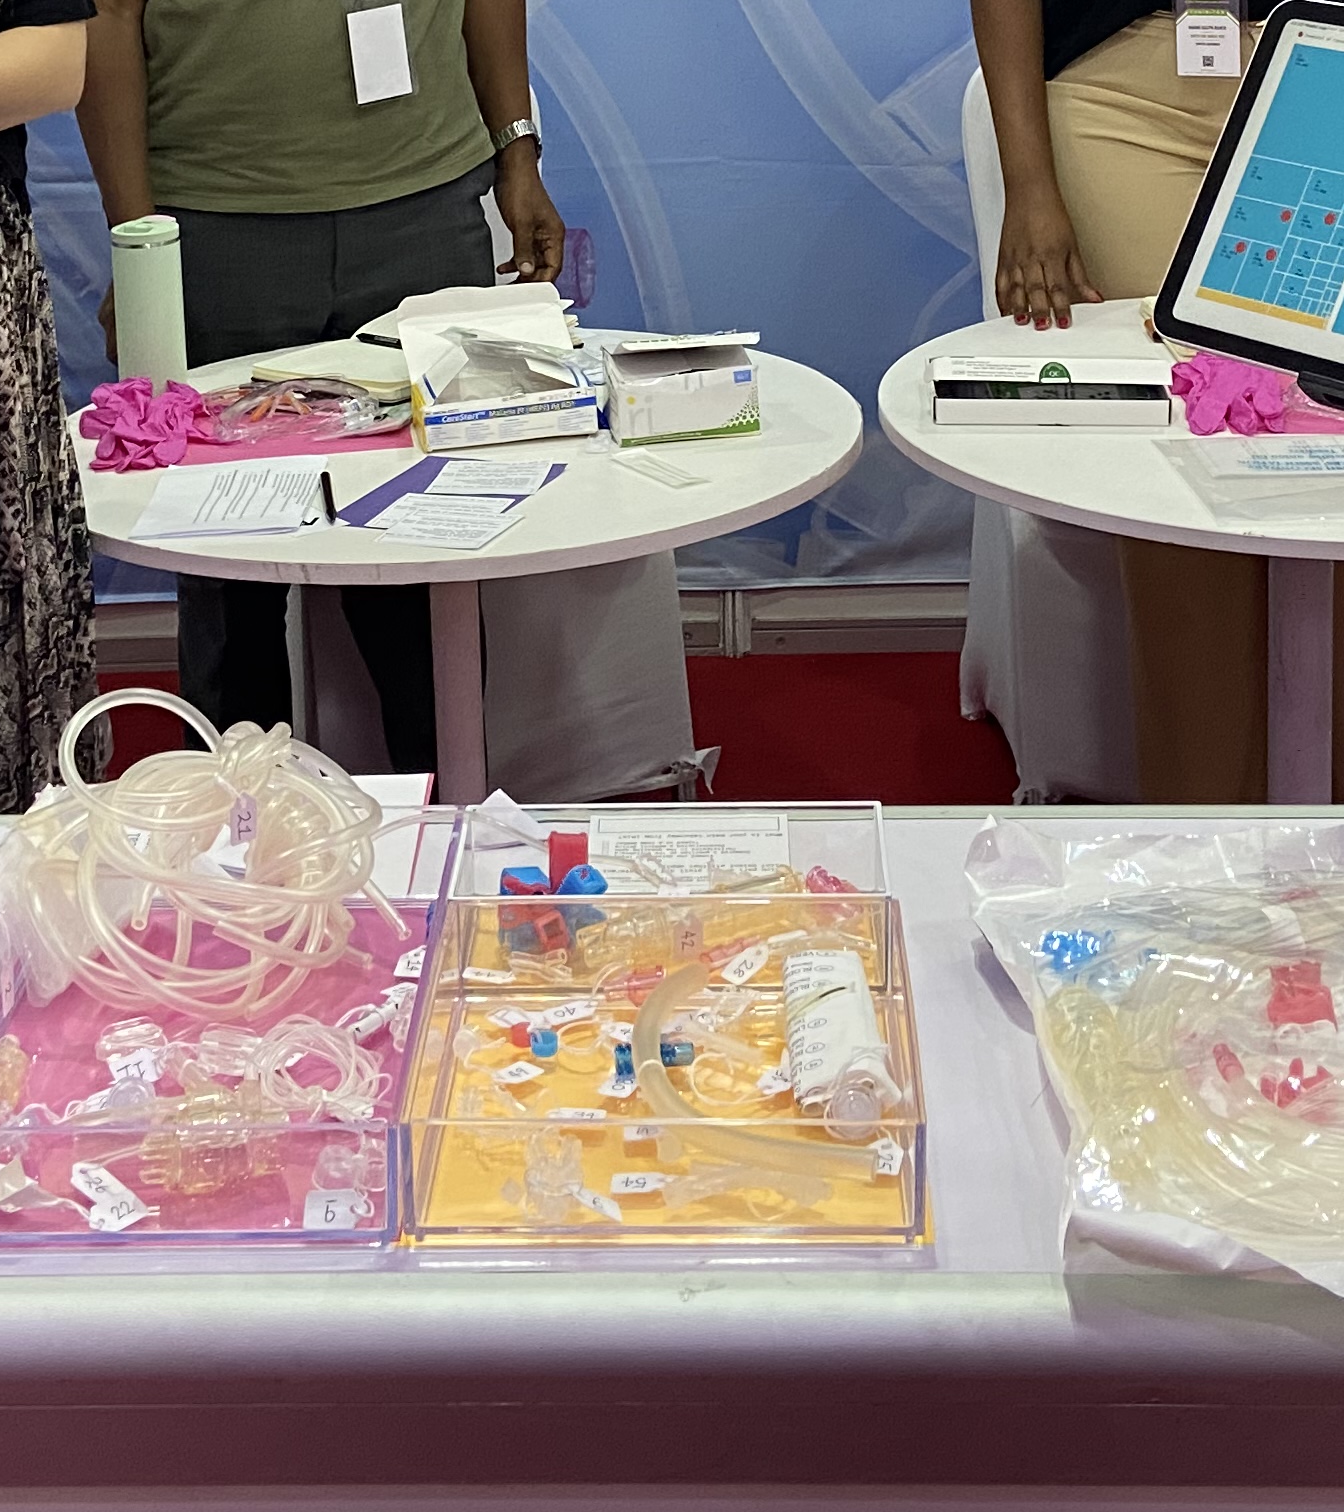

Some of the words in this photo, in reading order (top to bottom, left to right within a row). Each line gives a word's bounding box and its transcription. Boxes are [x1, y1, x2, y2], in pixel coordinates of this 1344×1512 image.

[237, 811, 252, 840] 21
[680, 930, 694, 950] 42
[733, 960, 753, 978] 28
[111, 1201, 134, 1219] 22
